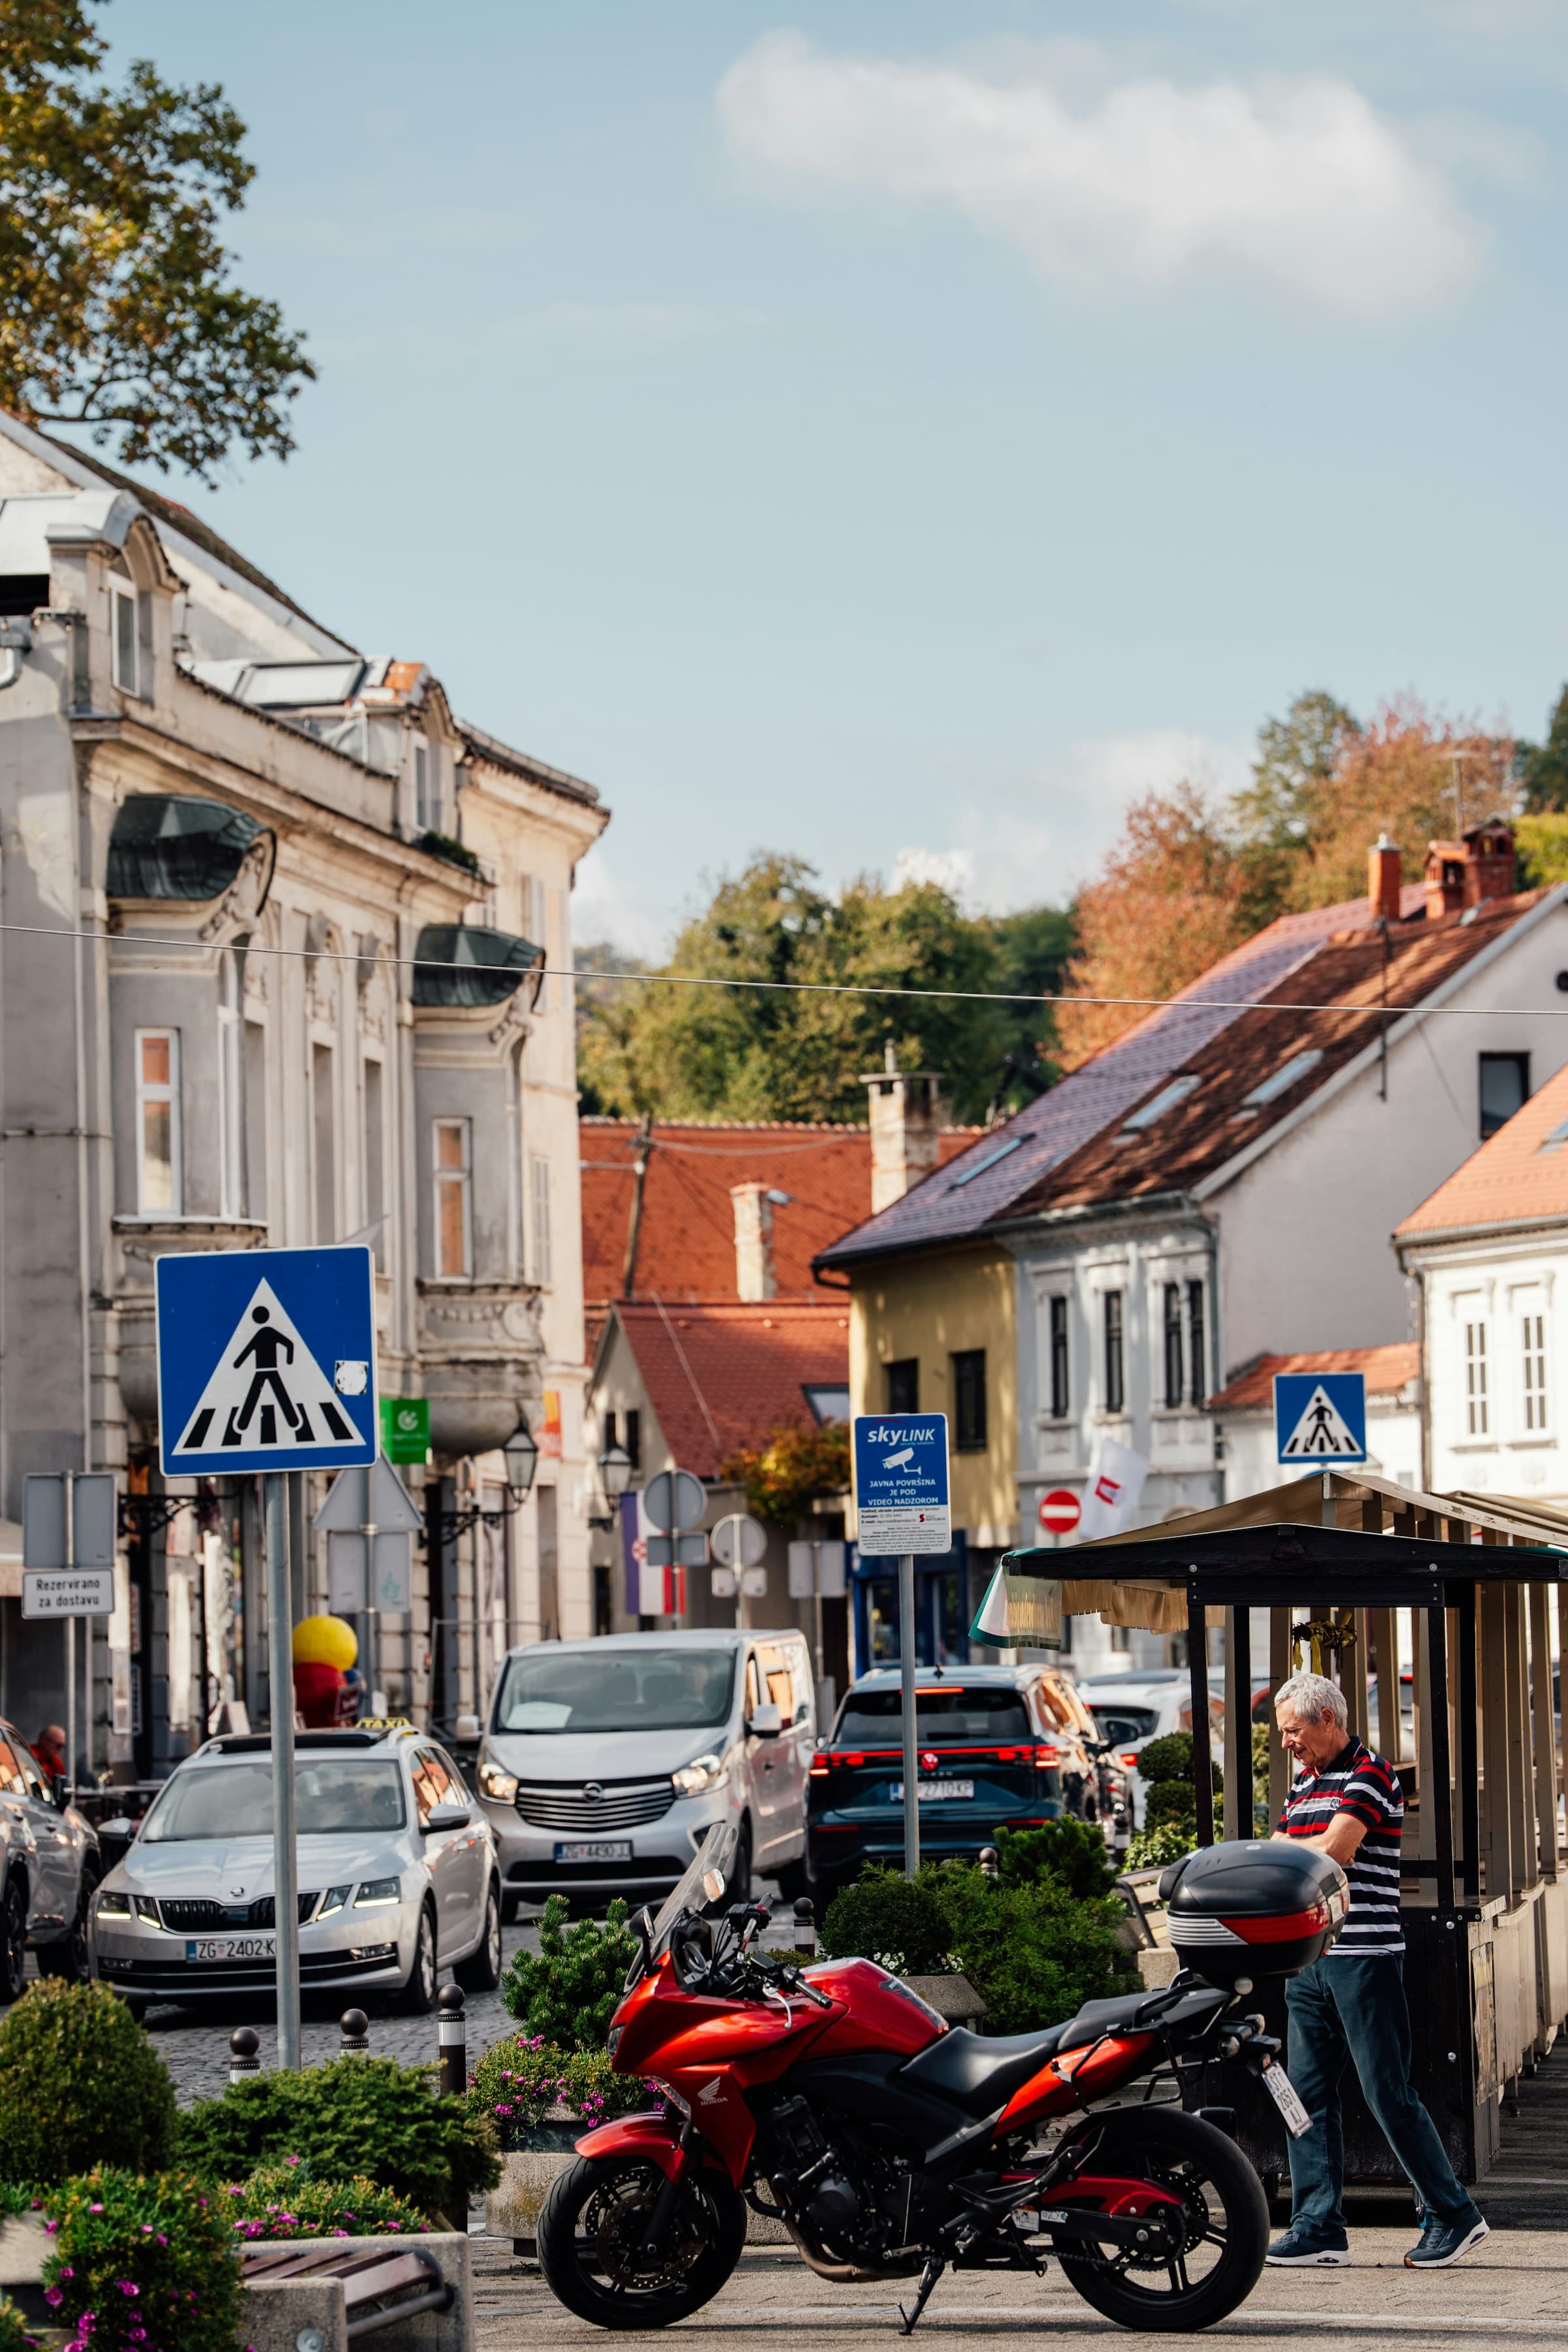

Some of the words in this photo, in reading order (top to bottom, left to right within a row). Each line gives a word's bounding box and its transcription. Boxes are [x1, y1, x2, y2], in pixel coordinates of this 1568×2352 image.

[896, 1478, 936, 1486] POVRŠINA
[37, 1578, 100, 1591] Rezervirano
[39, 1599, 50, 1608] za
[56, 1595, 99, 1607] dostavu
[363, 1719, 404, 1728] TAXI
[199, 1943, 216, 1959] ZG
[700, 2097, 728, 2106] HONDA
[1290, 2106, 1302, 2126] AJ
